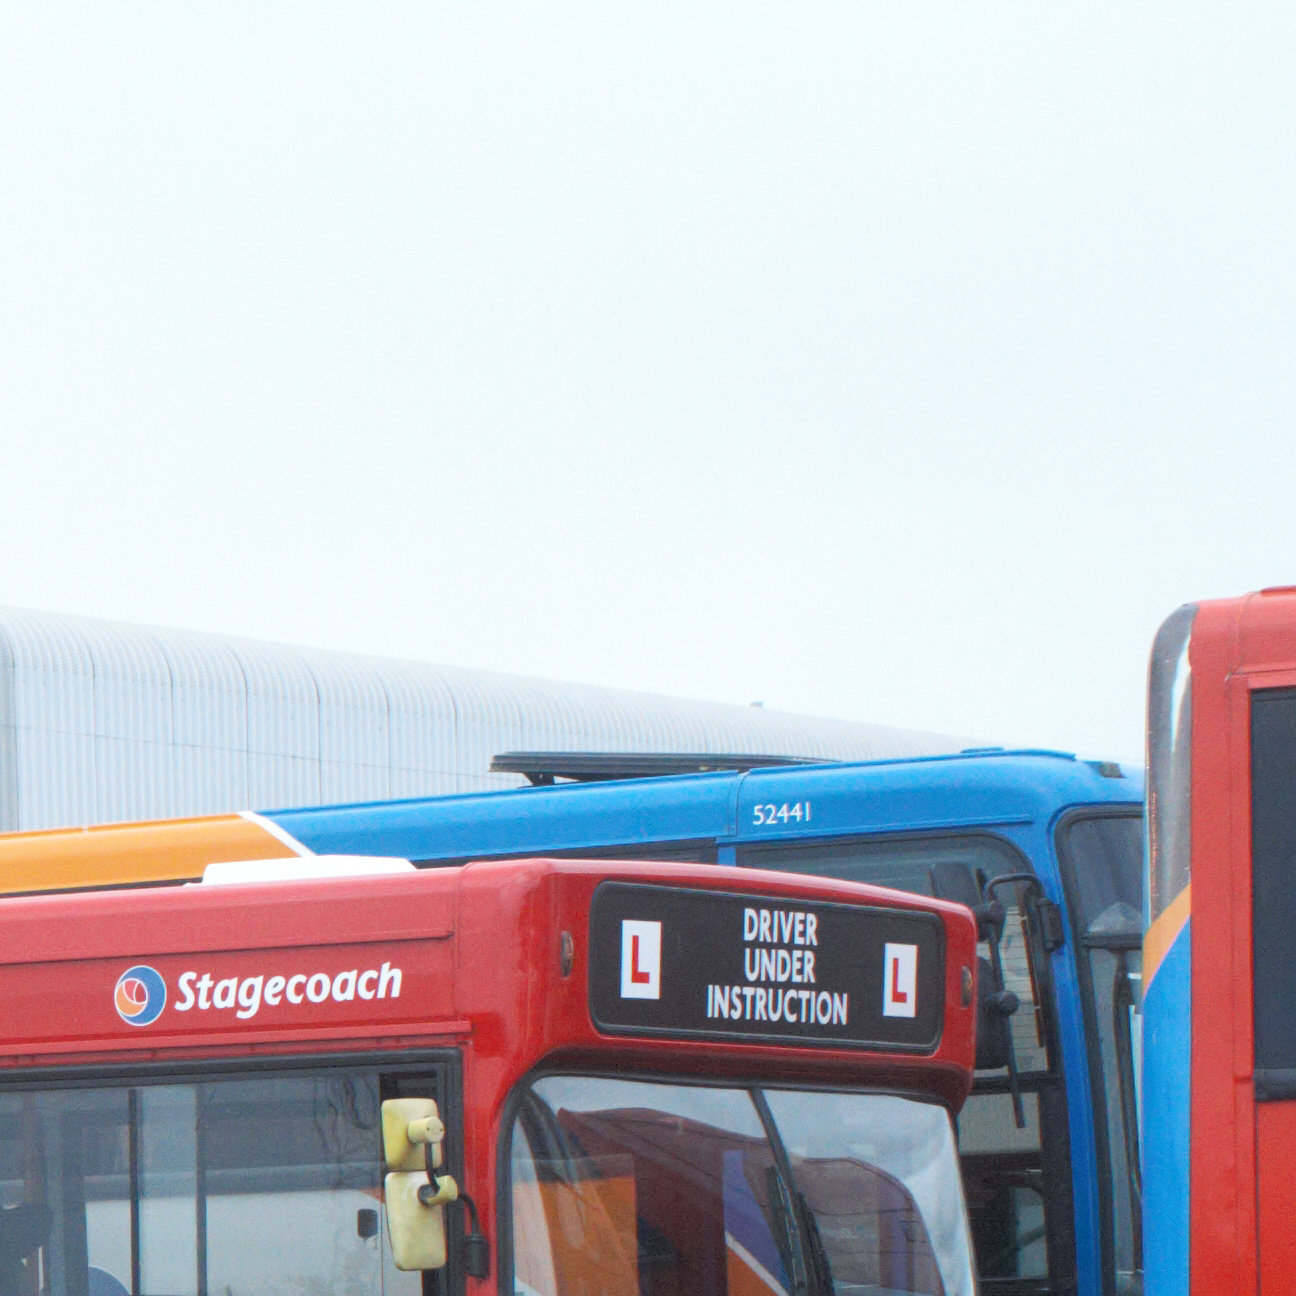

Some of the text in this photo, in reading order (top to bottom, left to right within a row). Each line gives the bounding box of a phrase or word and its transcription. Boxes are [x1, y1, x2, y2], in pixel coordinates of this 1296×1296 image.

[752, 801, 811, 826] 52441
[743, 907, 819, 946] DRIVER
[631, 934, 650, 984] L
[744, 948, 816, 983] UNDER
[174, 961, 403, 1019] Stagecoach
[892, 957, 907, 1003] L
[707, 984, 848, 1025] INSTRUCTION
